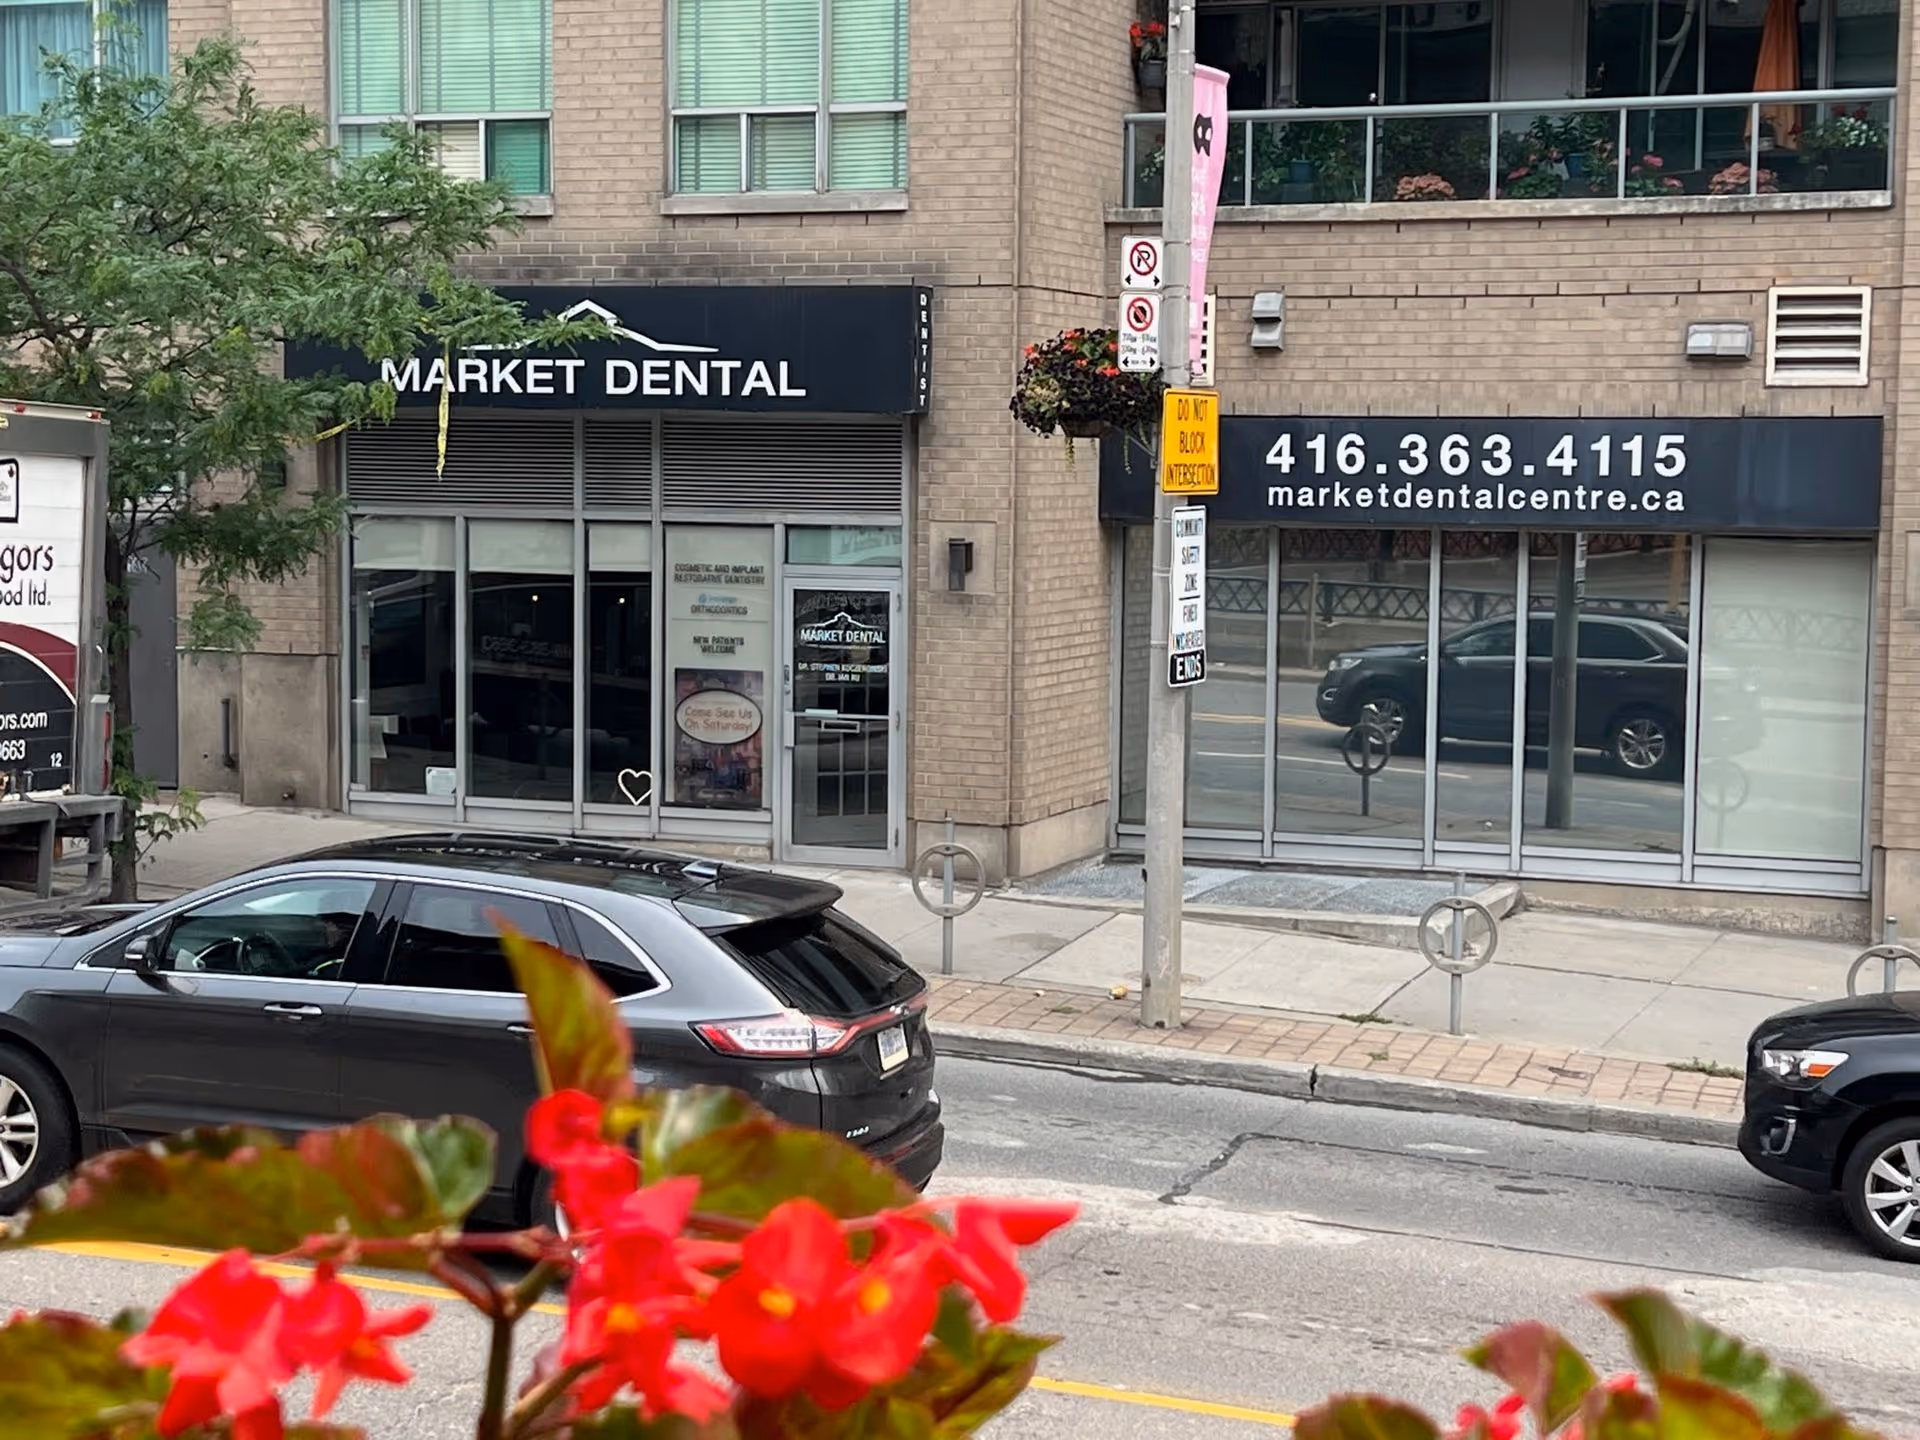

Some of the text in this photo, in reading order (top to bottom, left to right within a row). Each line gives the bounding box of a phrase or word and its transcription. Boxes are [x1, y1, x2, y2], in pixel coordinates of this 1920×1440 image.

[919, 293, 929, 406] DENTIST
[381, 357, 807, 397] MARKET DENTAL
[1178, 397, 1208, 421] DO NOT
[1179, 430, 1206, 454] BLOCK
[1265, 432, 1687, 477] 416.363.4115
[1165, 463, 1216, 488] INTERSECTION
[1267, 481, 1685, 511] marketdentalcentre.ca
[0, 545, 54, 584] gors
[674, 563, 713, 573] COSMETIC
[29, 578, 51, 606] ltd.
[1184, 573, 1198, 592] ZONE
[800, 629, 886, 643] MARKET DENTAL
[1175, 655, 1201, 681] ENDS
[685, 706, 752, 719] Come See Us
[685, 719, 700, 729] On
[0, 738, 26, 761] 663
[50, 751, 63, 768] 12
